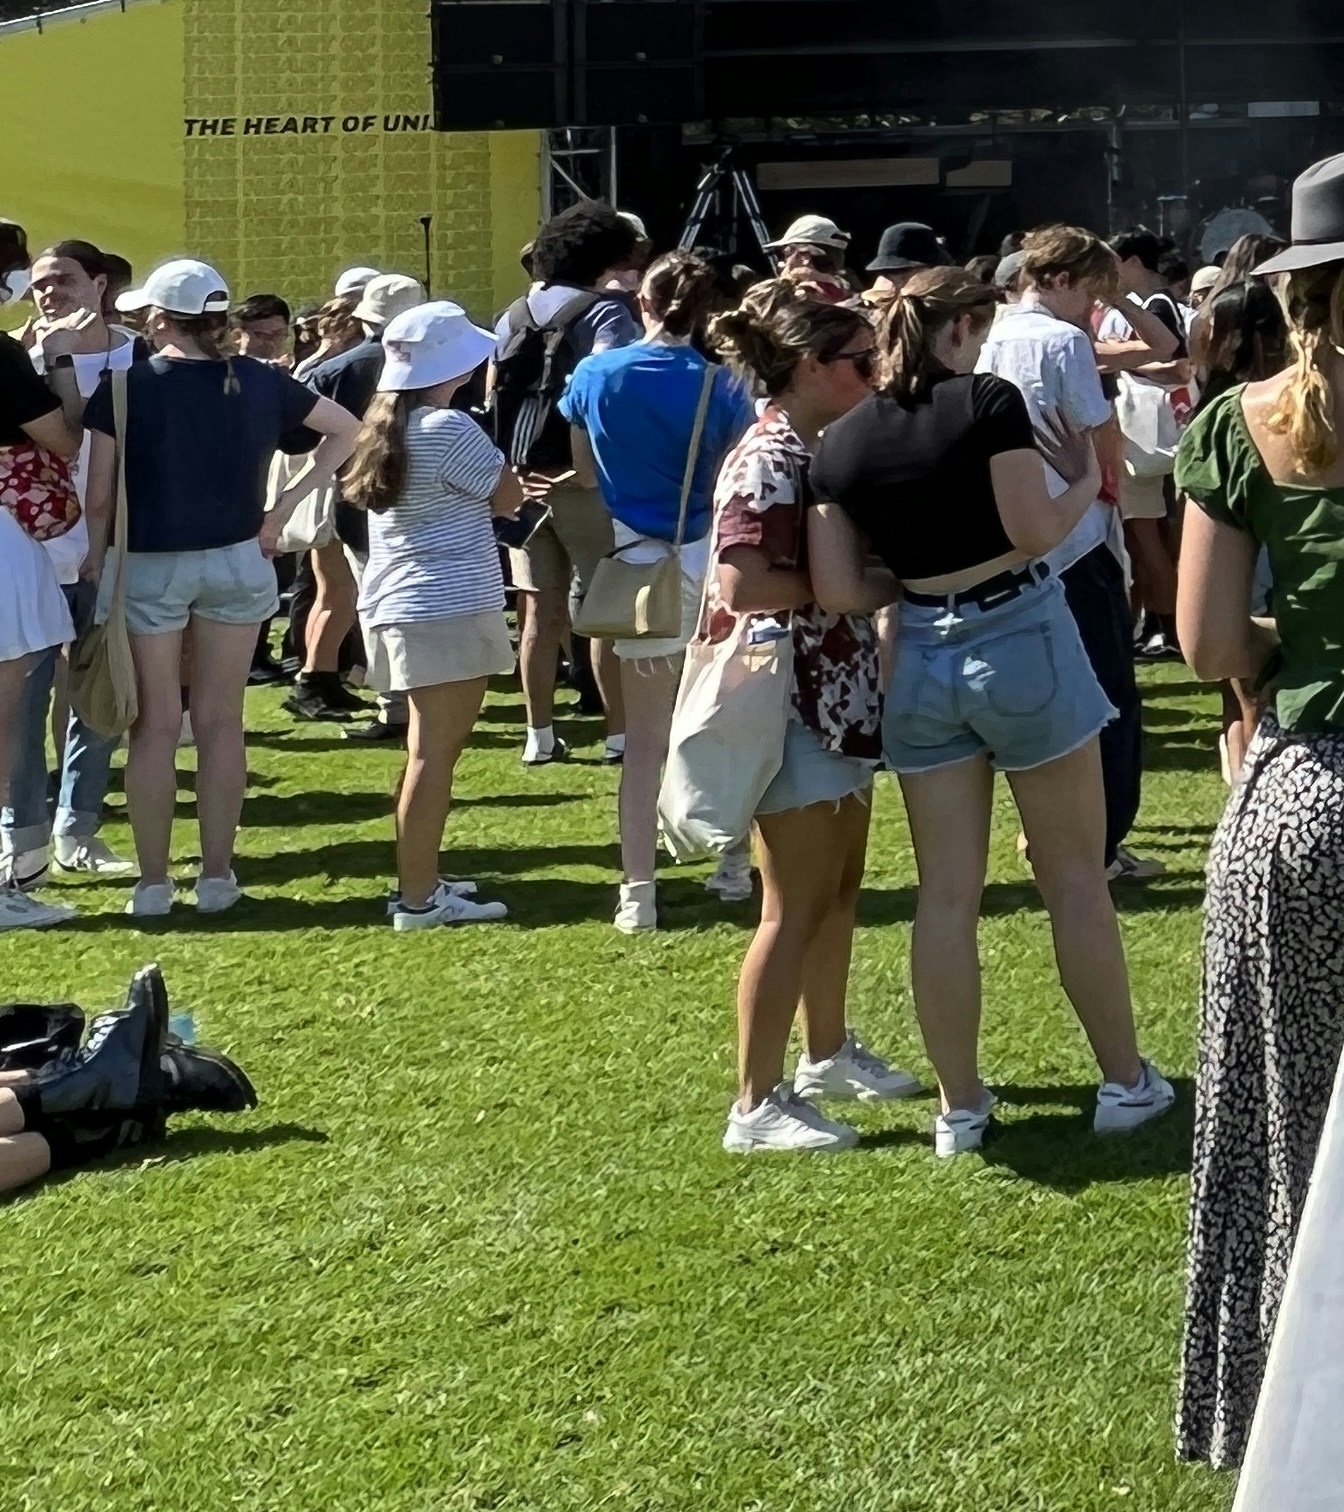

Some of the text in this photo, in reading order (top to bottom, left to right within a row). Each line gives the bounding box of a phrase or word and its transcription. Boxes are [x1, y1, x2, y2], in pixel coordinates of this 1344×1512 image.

[184, 113, 430, 137] THE HEART OF UNI
